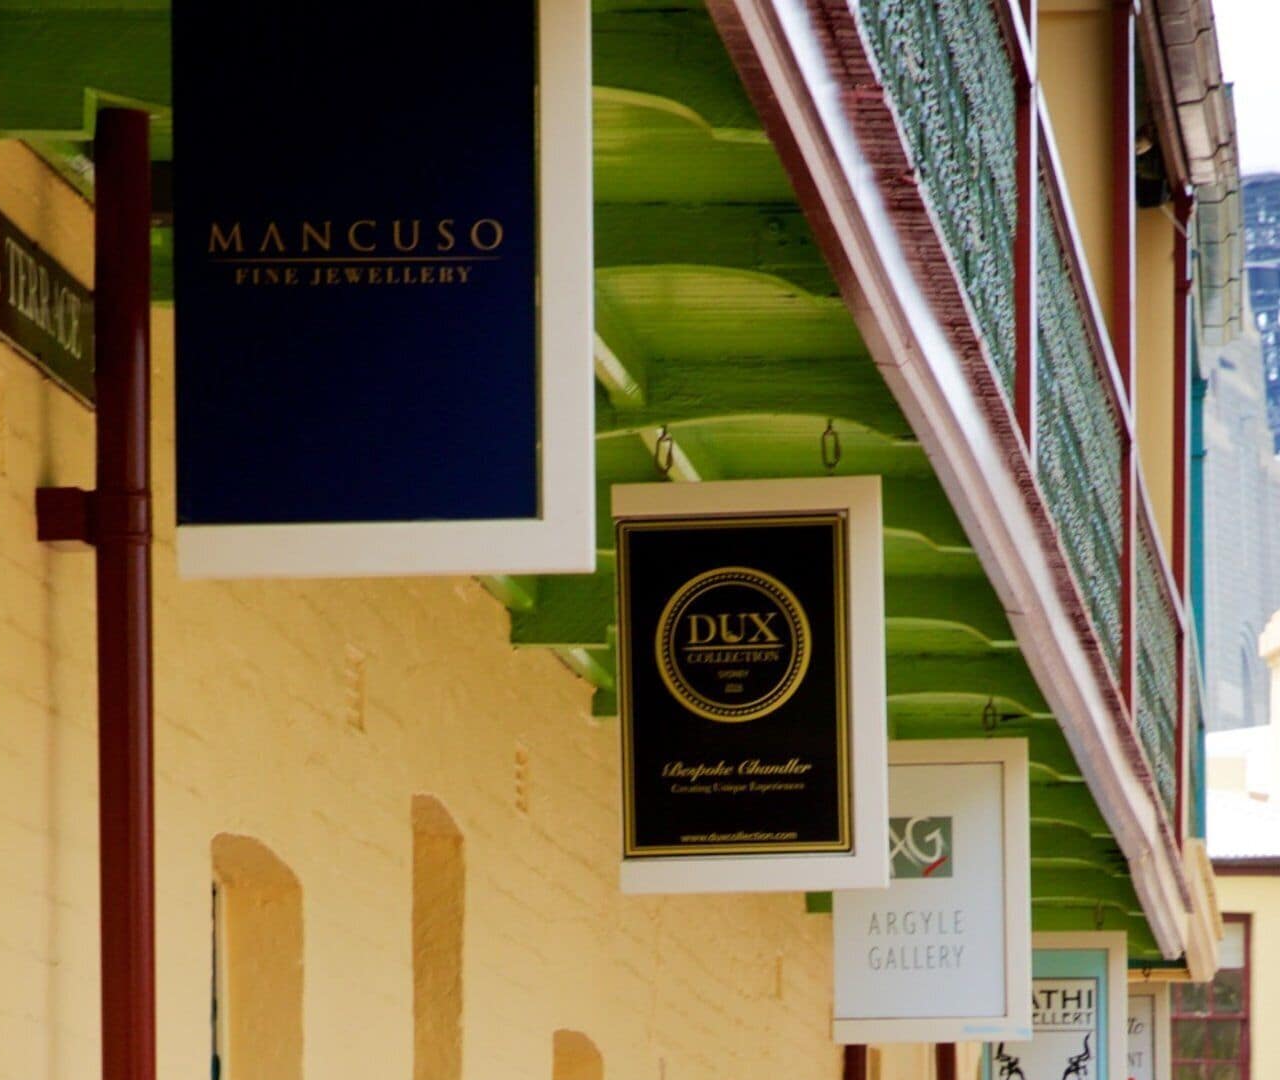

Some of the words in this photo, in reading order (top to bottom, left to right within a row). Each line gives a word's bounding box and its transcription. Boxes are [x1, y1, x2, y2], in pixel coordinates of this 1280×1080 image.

[208, 218, 504, 252] MANCUSO
[235, 268, 299, 285] FINE
[309, 266, 472, 285] JEWELLERY
[687, 612, 780, 644] DUX
[687, 650, 780, 664] COLLECTION
[661, 760, 734, 782] Bespoke
[737, 758, 812, 776] Chandler
[868, 909, 964, 936] ARGYLE
[868, 944, 965, 970] GALLERY
[1032, 988, 1092, 1009] THI
[1032, 1012, 1093, 1025] ELLERY
